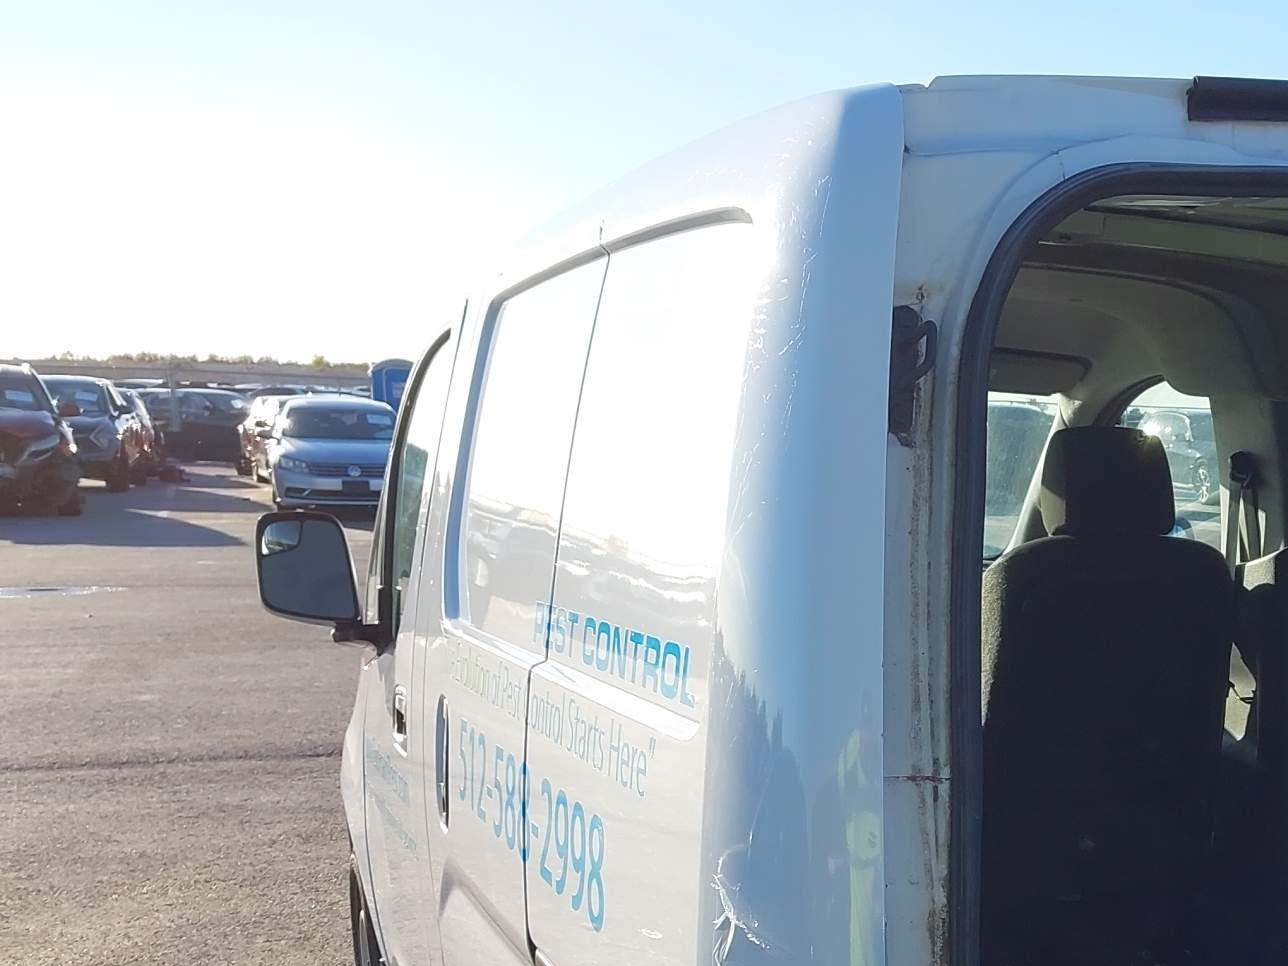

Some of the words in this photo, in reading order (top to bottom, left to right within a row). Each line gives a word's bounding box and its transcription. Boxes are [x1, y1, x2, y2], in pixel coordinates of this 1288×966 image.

[534, 601, 579, 657] PEST
[583, 615, 696, 708] CONTROL
[524, 685, 565, 746] Control
[567, 697, 605, 770] Starts
[459, 718, 605, 933] 512-588-2998
